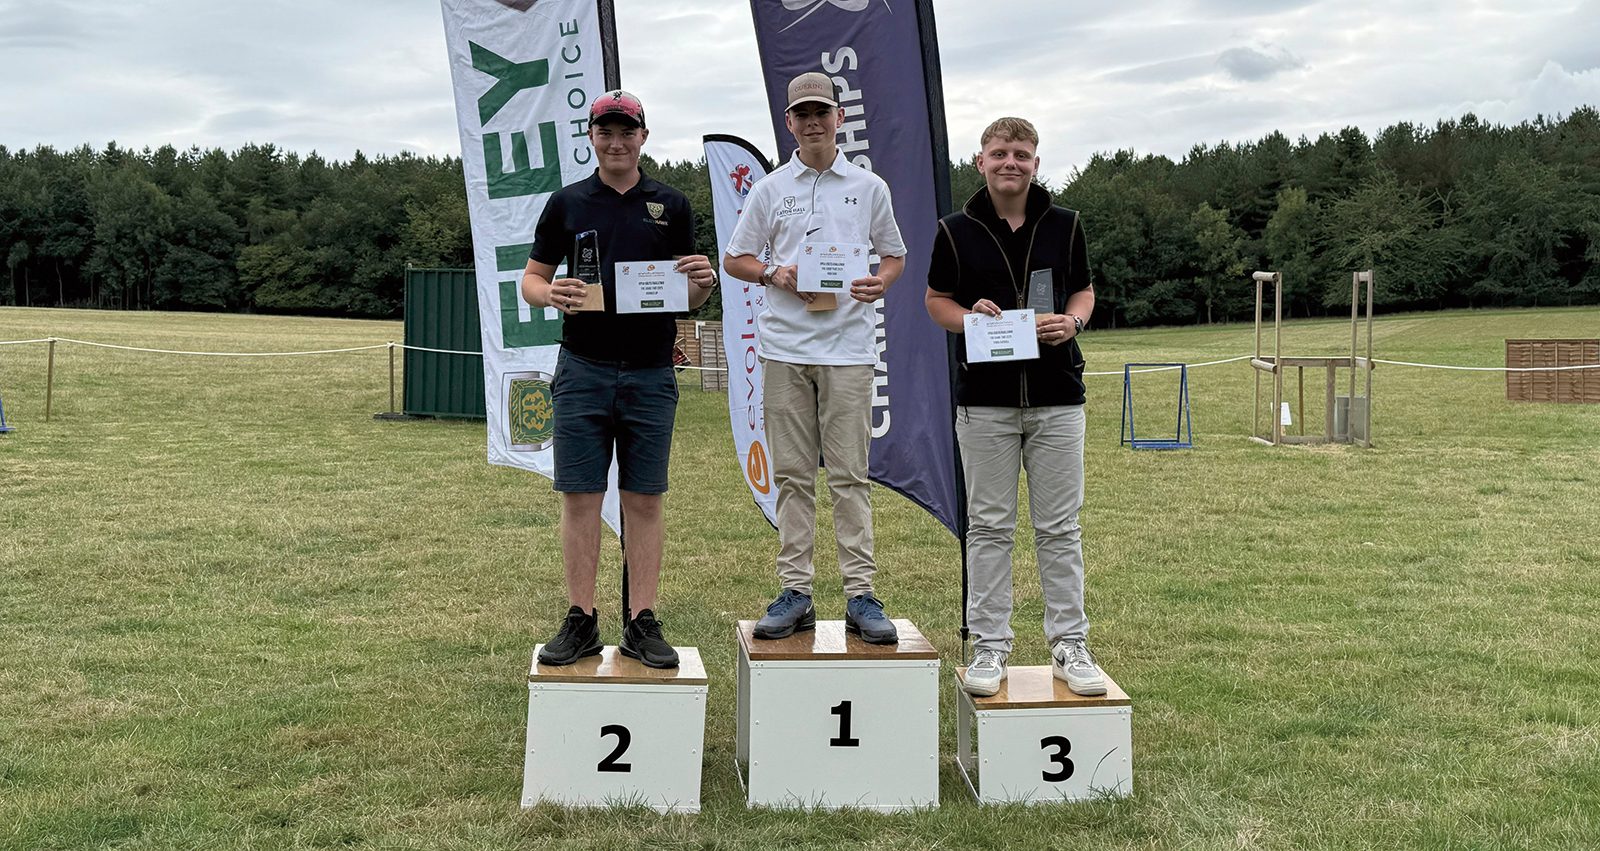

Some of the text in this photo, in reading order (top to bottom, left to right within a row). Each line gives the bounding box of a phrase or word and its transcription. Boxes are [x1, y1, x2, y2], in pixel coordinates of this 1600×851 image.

[559, 18, 592, 165] CHOICE
[829, 700, 860, 747] 1
[597, 724, 632, 773] 2
[1040, 735, 1075, 783] 3
